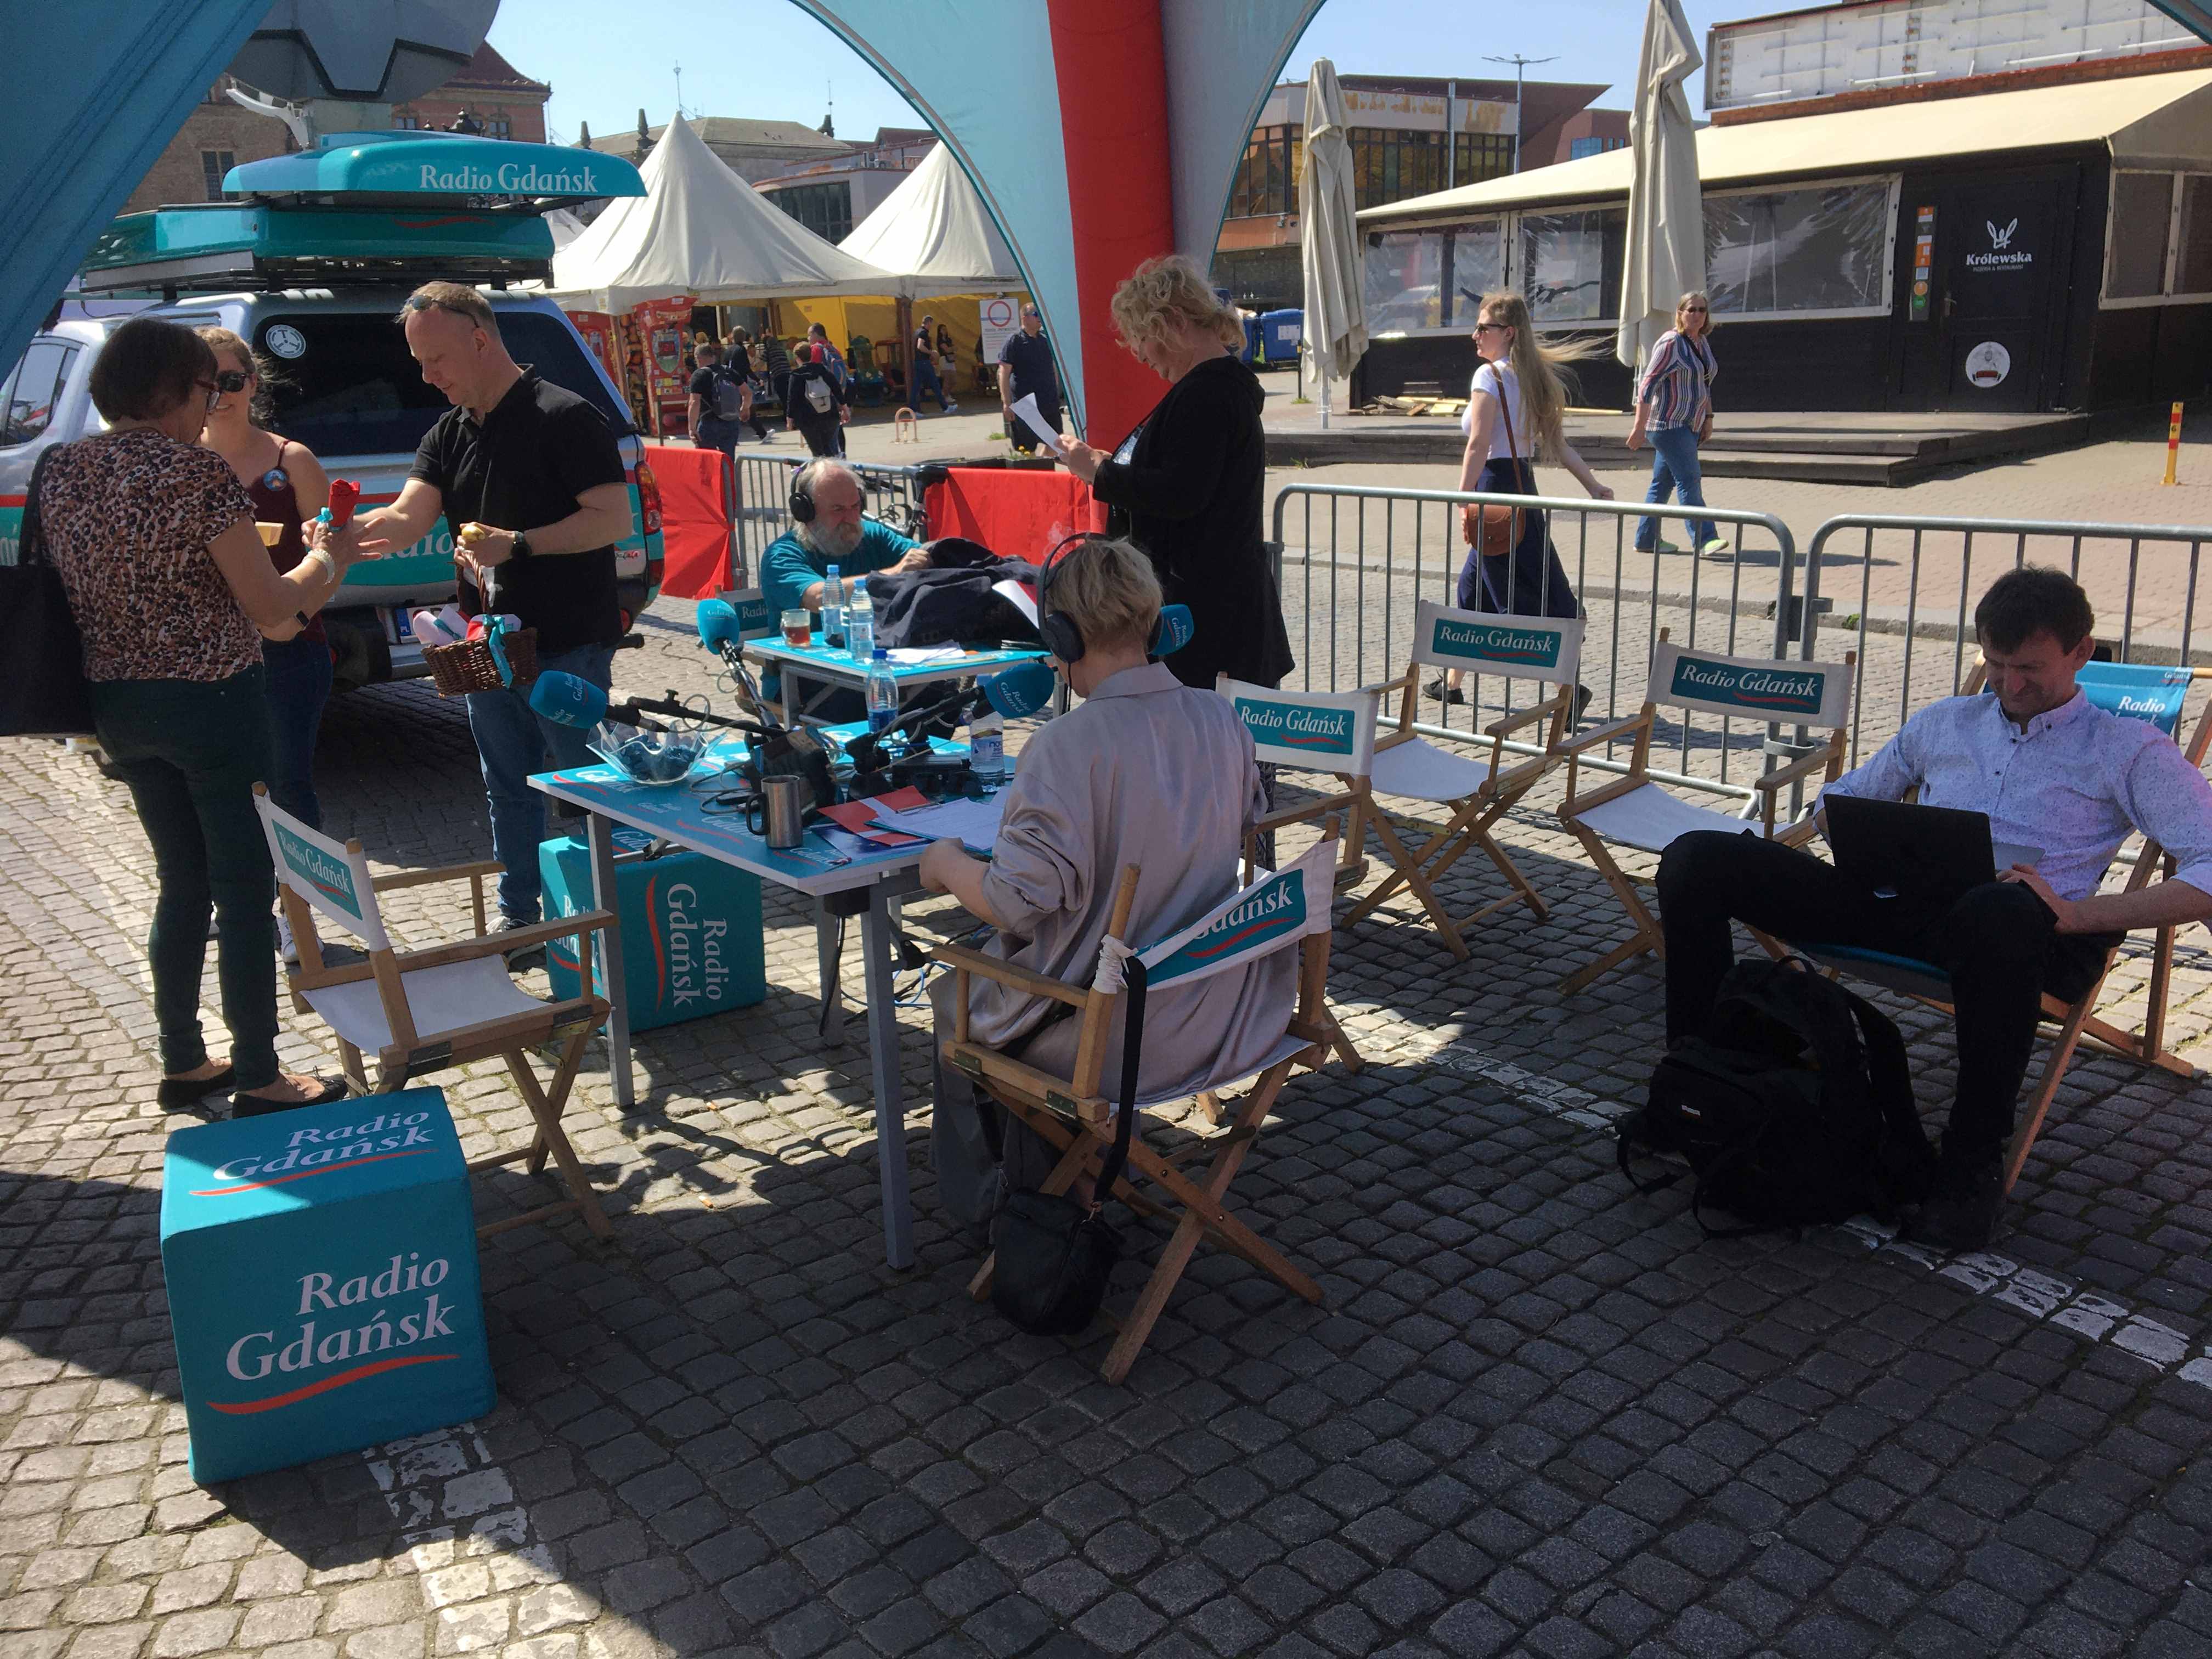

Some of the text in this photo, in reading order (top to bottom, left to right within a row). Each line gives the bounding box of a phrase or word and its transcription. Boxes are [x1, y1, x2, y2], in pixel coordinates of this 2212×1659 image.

[419, 163, 599, 193] Radio Gdańsk
[1966, 251, 2032, 266] Królewska
[742, 604, 768, 619] Radi
[1440, 626, 1554, 652] Radio Gdańsk
[1680, 664, 1818, 696] Radio Gdańsk
[1240, 706, 1348, 736] Radio Gdańsk
[2118, 696, 2166, 713] Radio
[279, 832, 351, 895] Radio Gdańsk
[667, 883, 702, 1008] Gdańsk
[702, 917, 730, 1001] Radio
[285, 1111, 429, 1149] Radio
[213, 1126, 435, 1180] Gdańsk
[296, 1251, 449, 1316] Radio
[226, 1294, 455, 1381] Gdańsk
